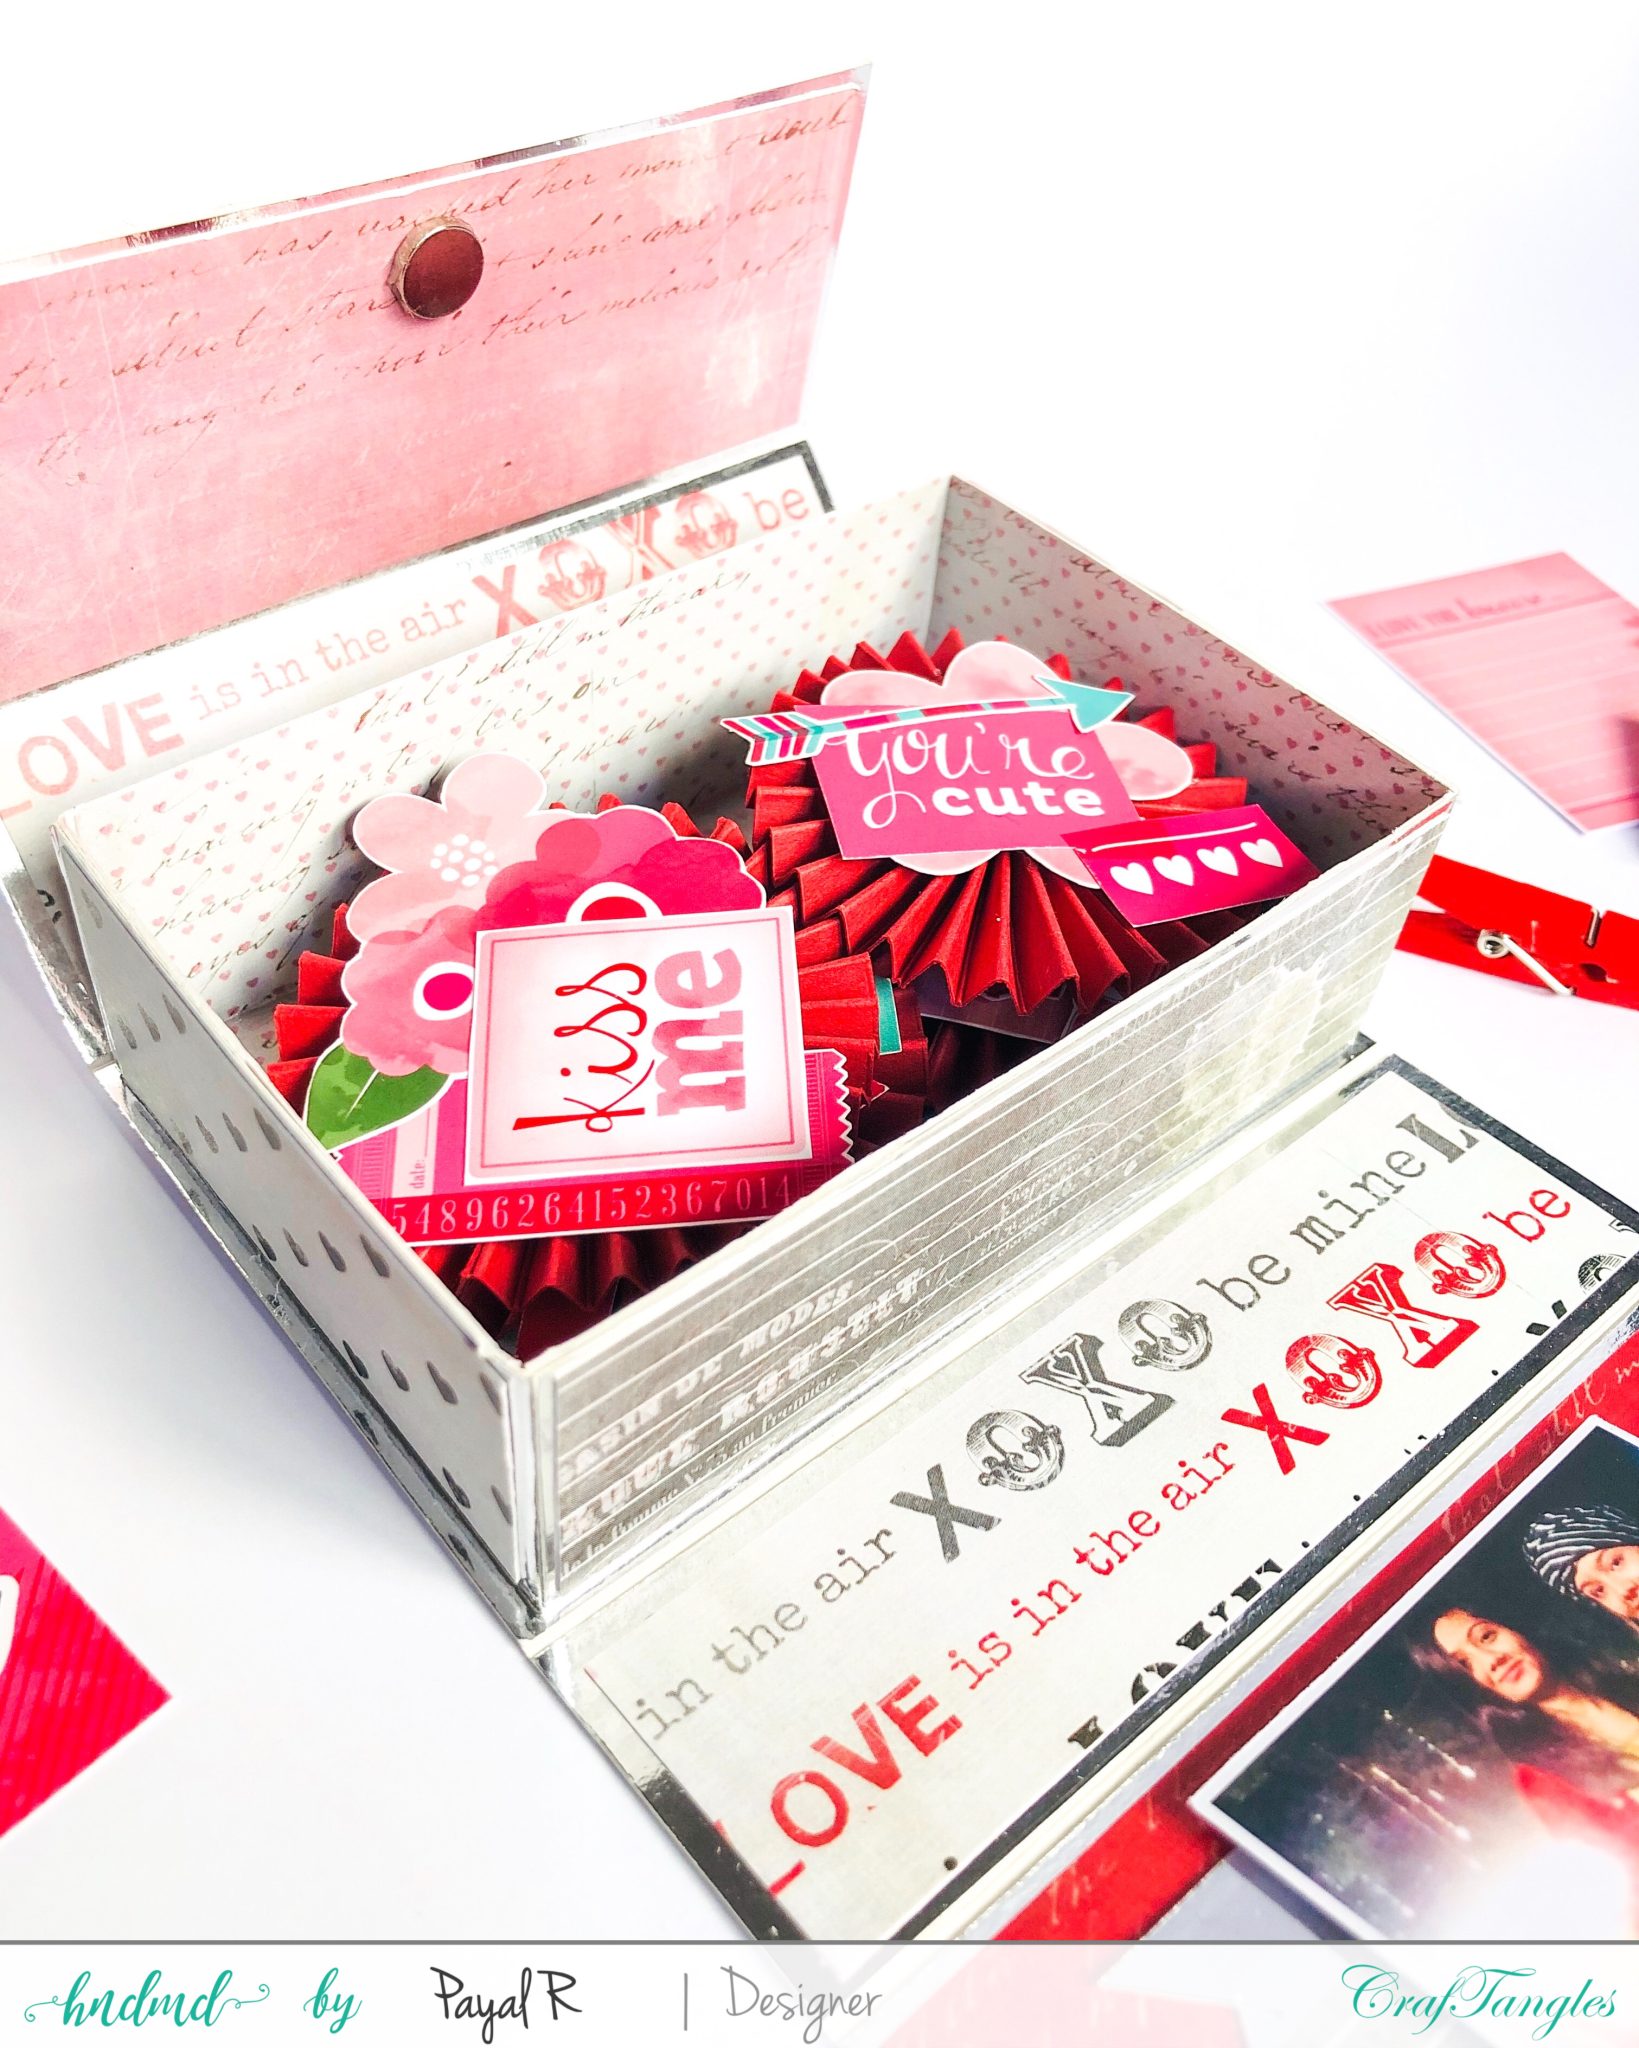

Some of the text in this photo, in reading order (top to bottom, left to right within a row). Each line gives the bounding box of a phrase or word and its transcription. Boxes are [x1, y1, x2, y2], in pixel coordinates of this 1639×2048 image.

[0, 693, 186, 820] OVE
[189, 681, 242, 721] is
[250, 656, 310, 699] in
[314, 622, 392, 673] the
[400, 597, 467, 644] air
[744, 487, 811, 532] be
[932, 781, 1106, 817] cute
[512, 961, 655, 1134] kiss
[653, 946, 746, 1118] me
[635, 1673, 714, 1740] in
[711, 1601, 809, 1675] the
[814, 1527, 898, 1603] air
[889, 1297, 1215, 1563] XOXO
[1195, 1252, 1292, 1312] be
[1289, 1149, 1427, 1254] mine
[713, 1674, 964, 1896] OVE
[949, 1631, 1013, 1690] is
[1010, 1577, 1083, 1636] in
[1072, 1509, 1162, 1576] the
[1160, 1441, 1237, 1511] air
[1220, 1230, 1507, 1476] XOXO
[1482, 1188, 1572, 1243] be
